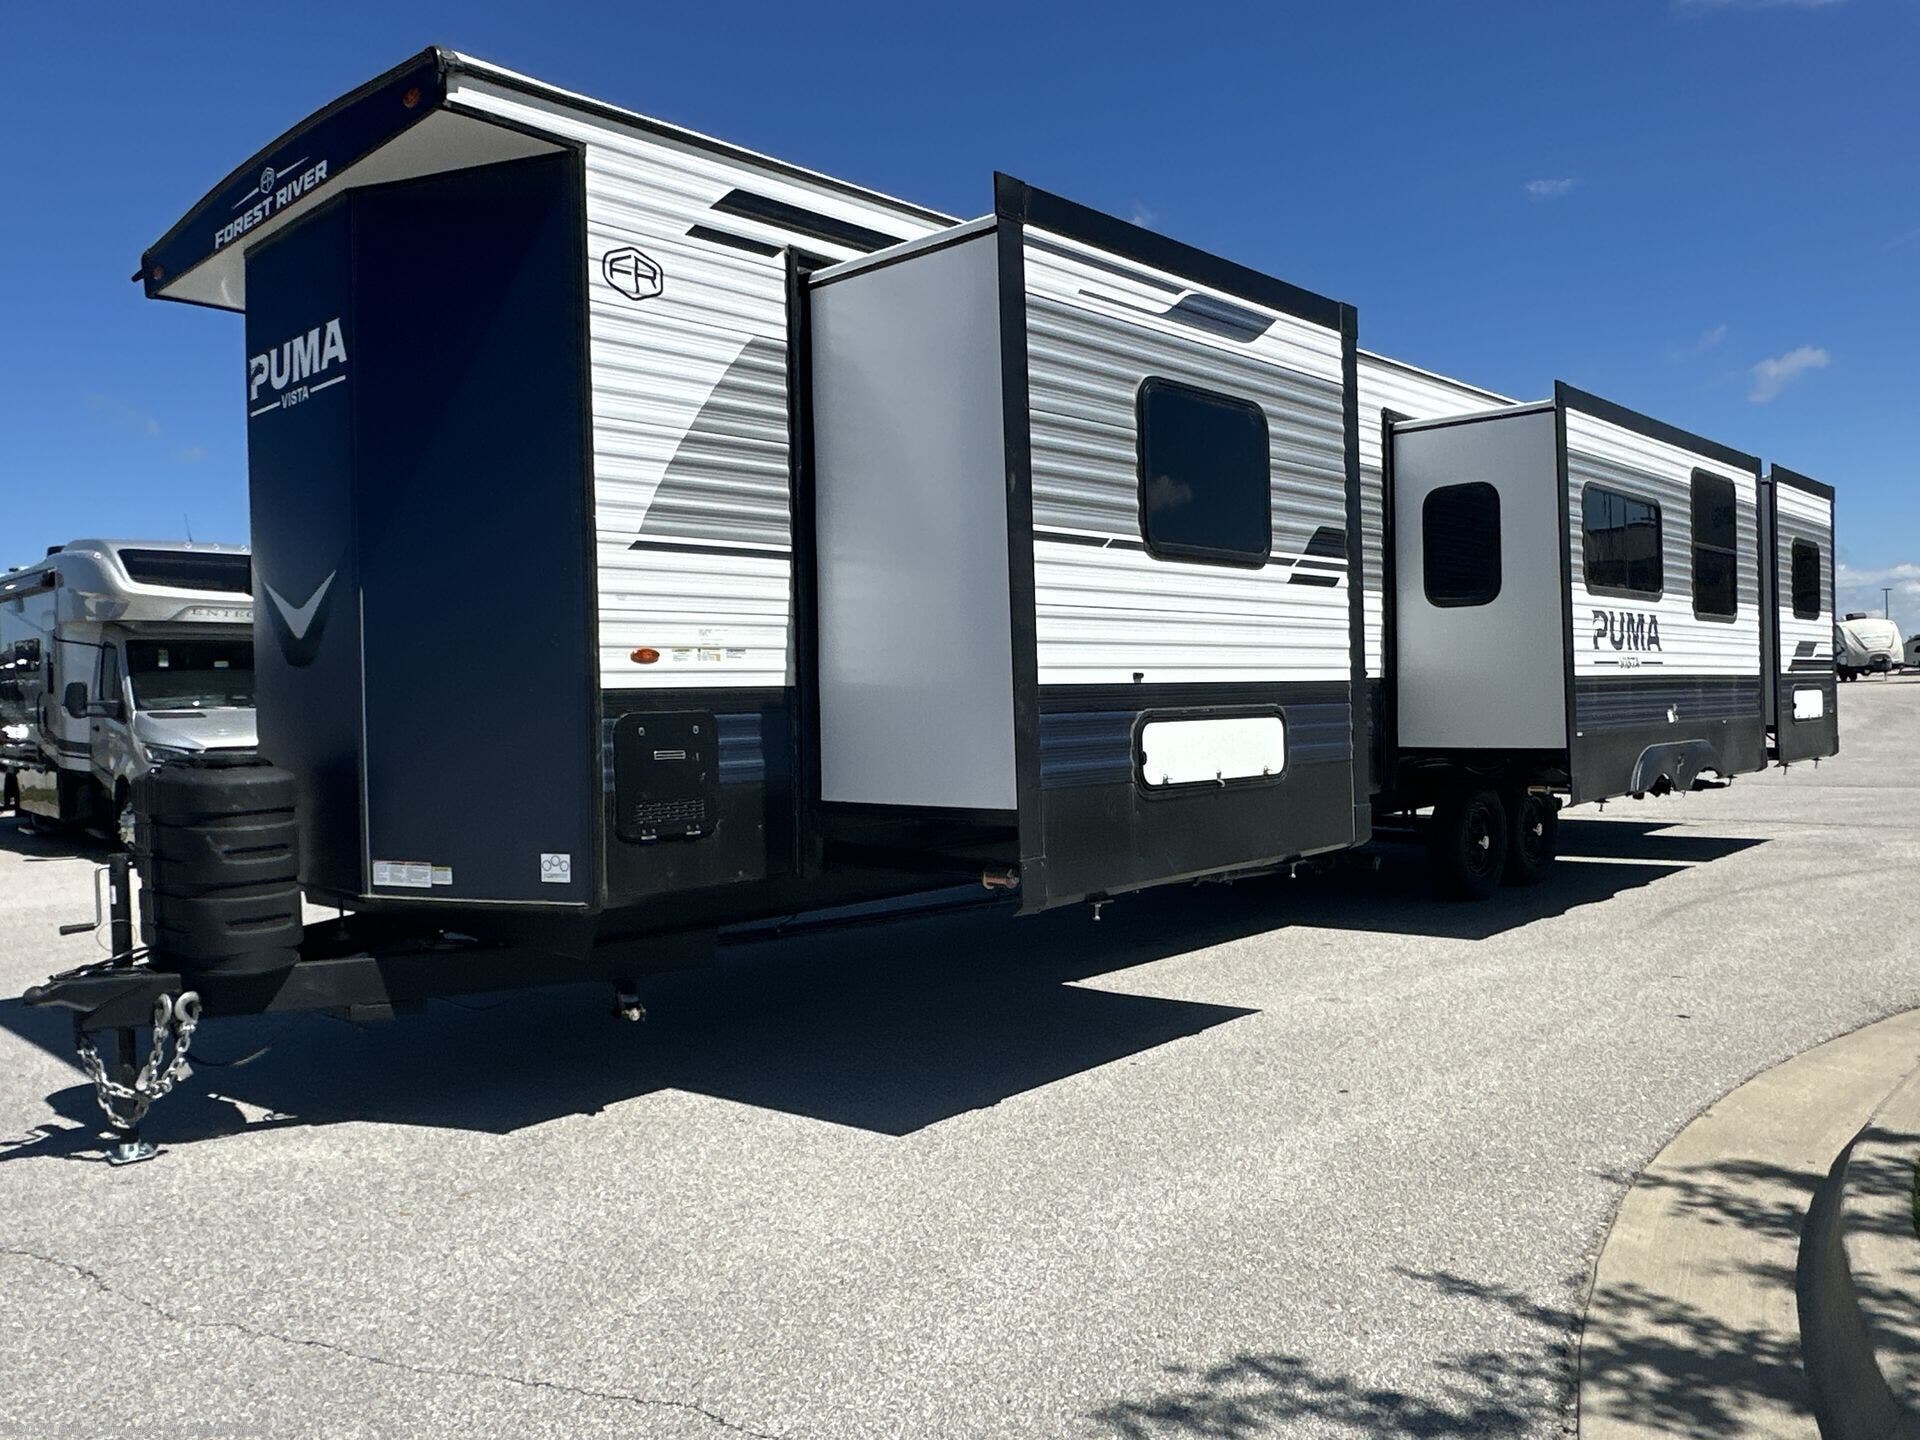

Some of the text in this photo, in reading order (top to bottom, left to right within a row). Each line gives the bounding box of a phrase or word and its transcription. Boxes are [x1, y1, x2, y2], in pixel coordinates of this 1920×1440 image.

[214, 160, 328, 250] FOREST RIVER
[609, 254, 658, 295] FR
[249, 317, 348, 401] PUMA
[281, 385, 309, 409] VISTA
[1591, 609, 1663, 652] PUMA
